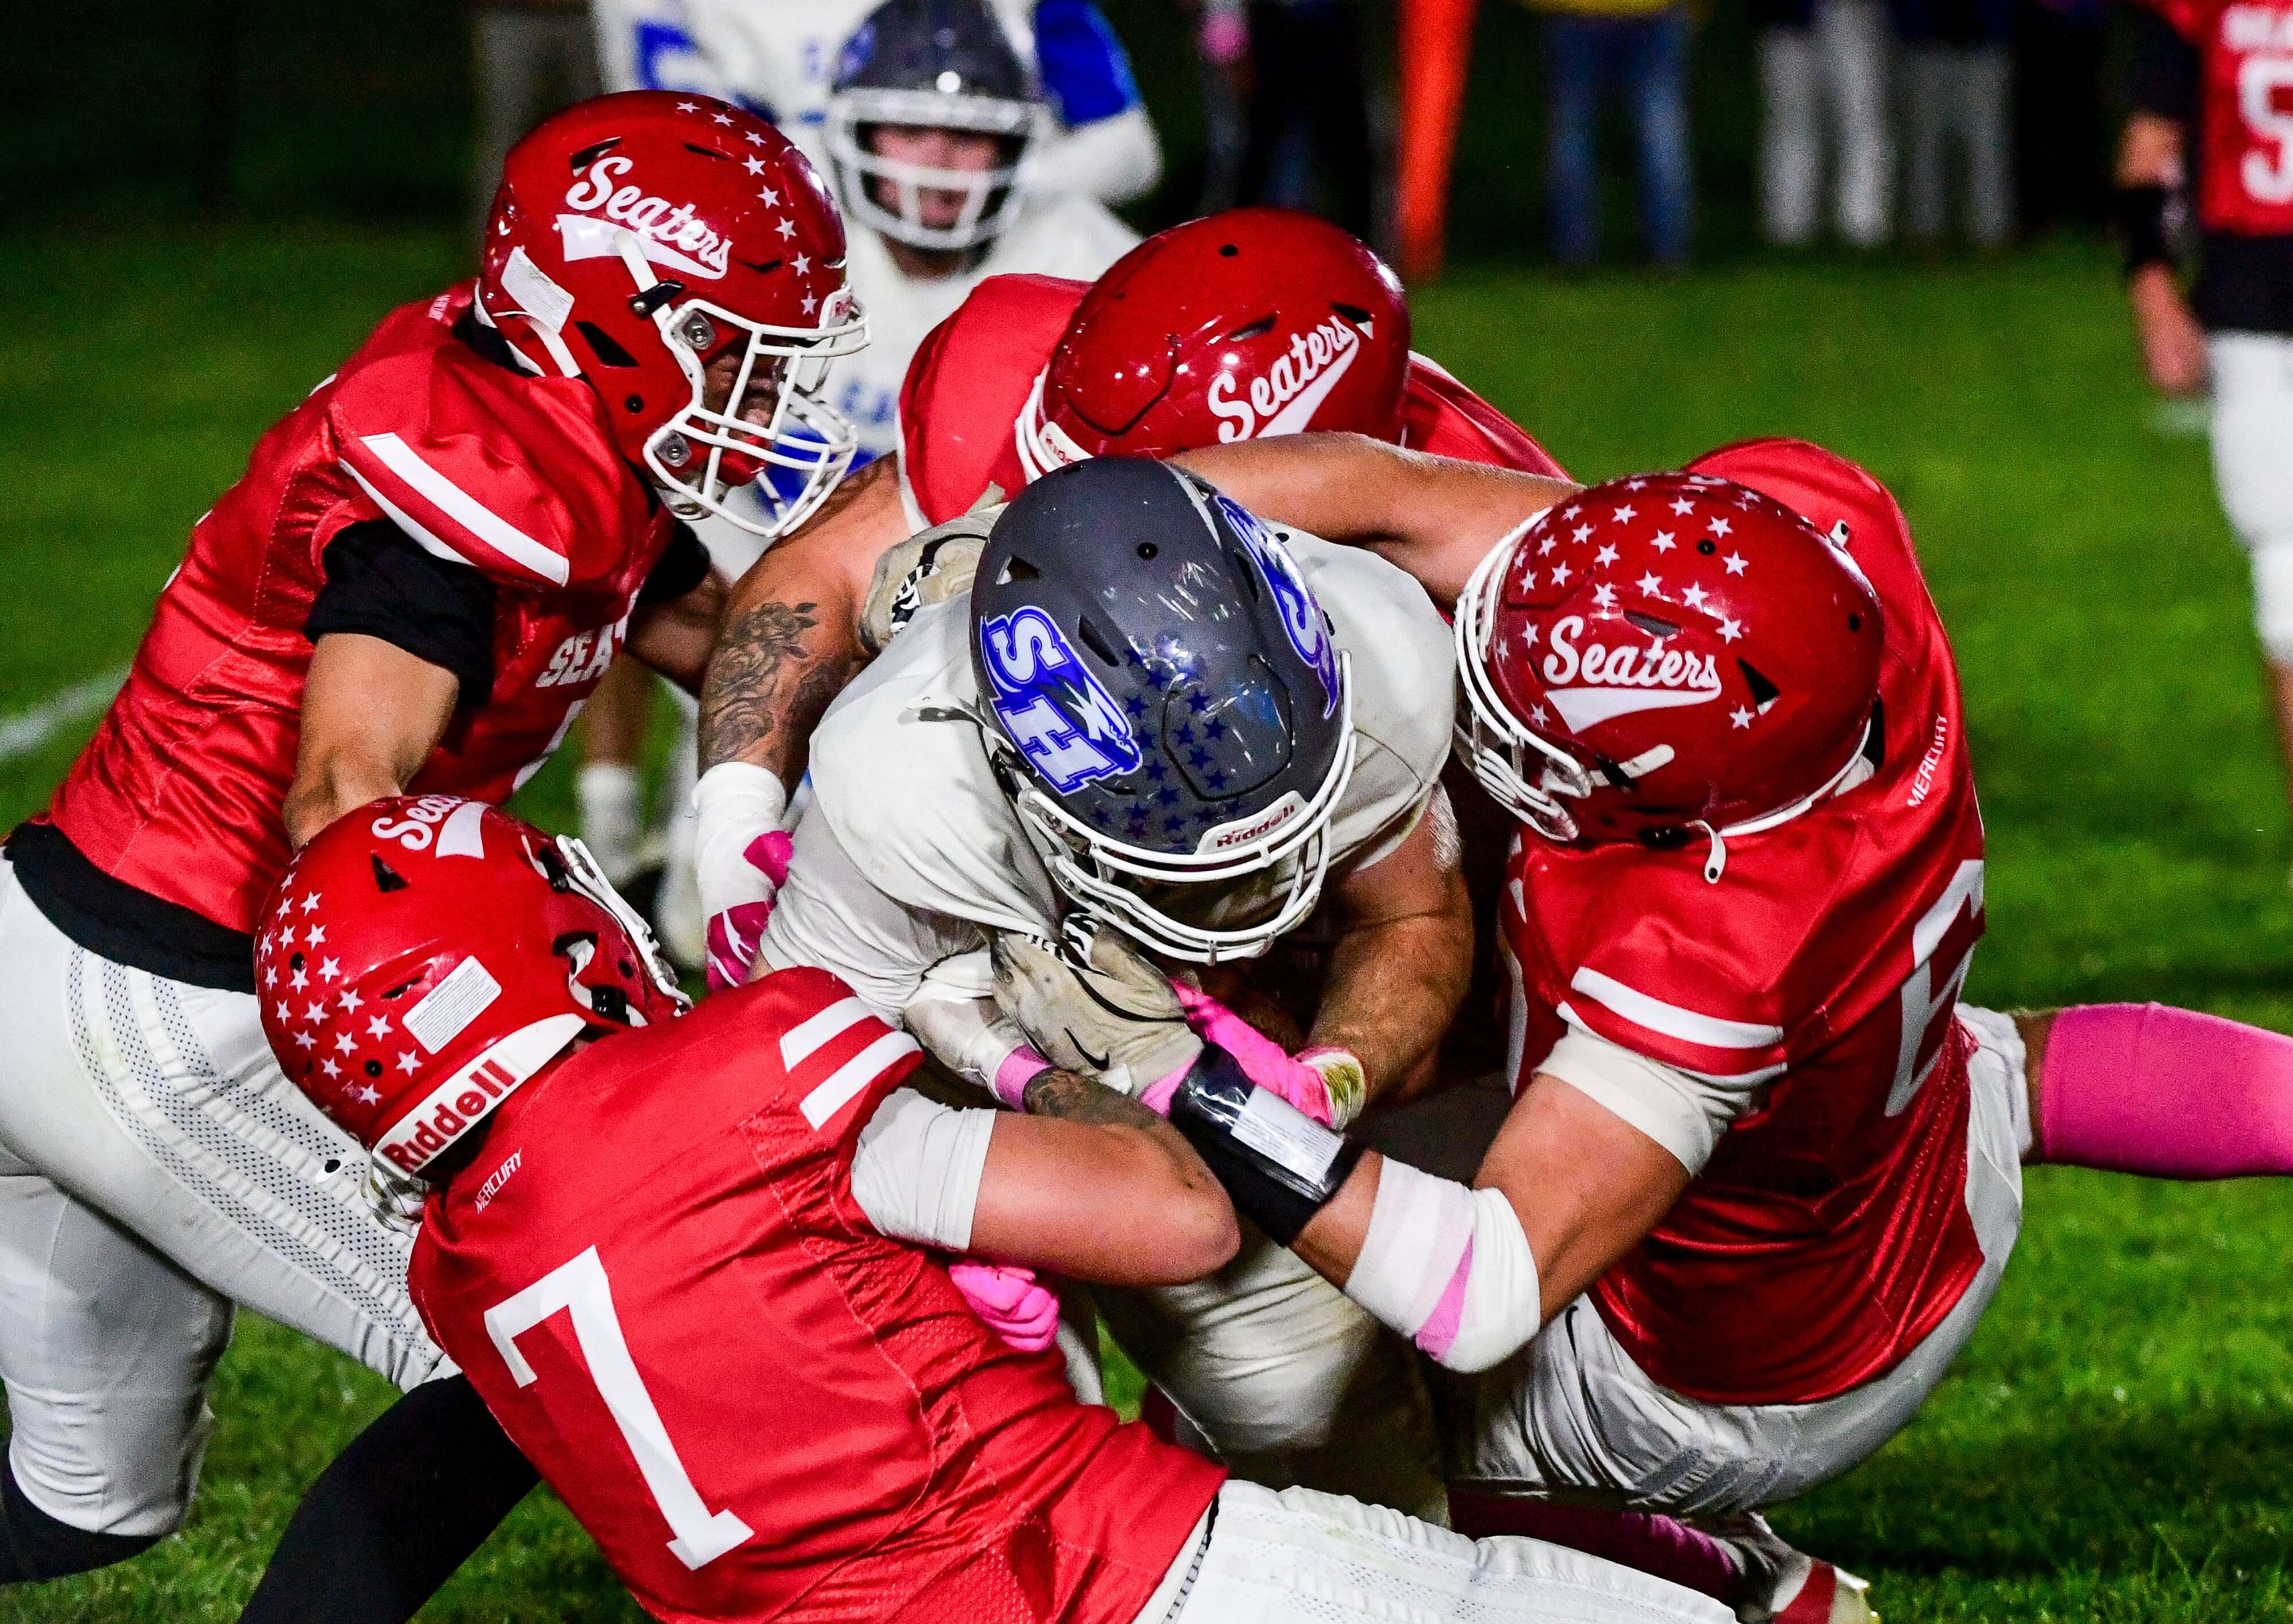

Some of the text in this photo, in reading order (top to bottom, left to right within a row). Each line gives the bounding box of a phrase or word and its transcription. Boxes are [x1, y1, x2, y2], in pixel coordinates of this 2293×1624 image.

[566, 156, 733, 271] Seaters
[1208, 315, 1357, 443] Seaters
[989, 613, 1117, 785] SH
[1544, 616, 1720, 688] Seaters
[371, 795, 462, 851] Sea
[1218, 804, 1295, 847] Riddell
[381, 1058, 516, 1173] Riddell
[474, 1147, 522, 1214] MERCURY
[484, 1245, 754, 1571] 7
